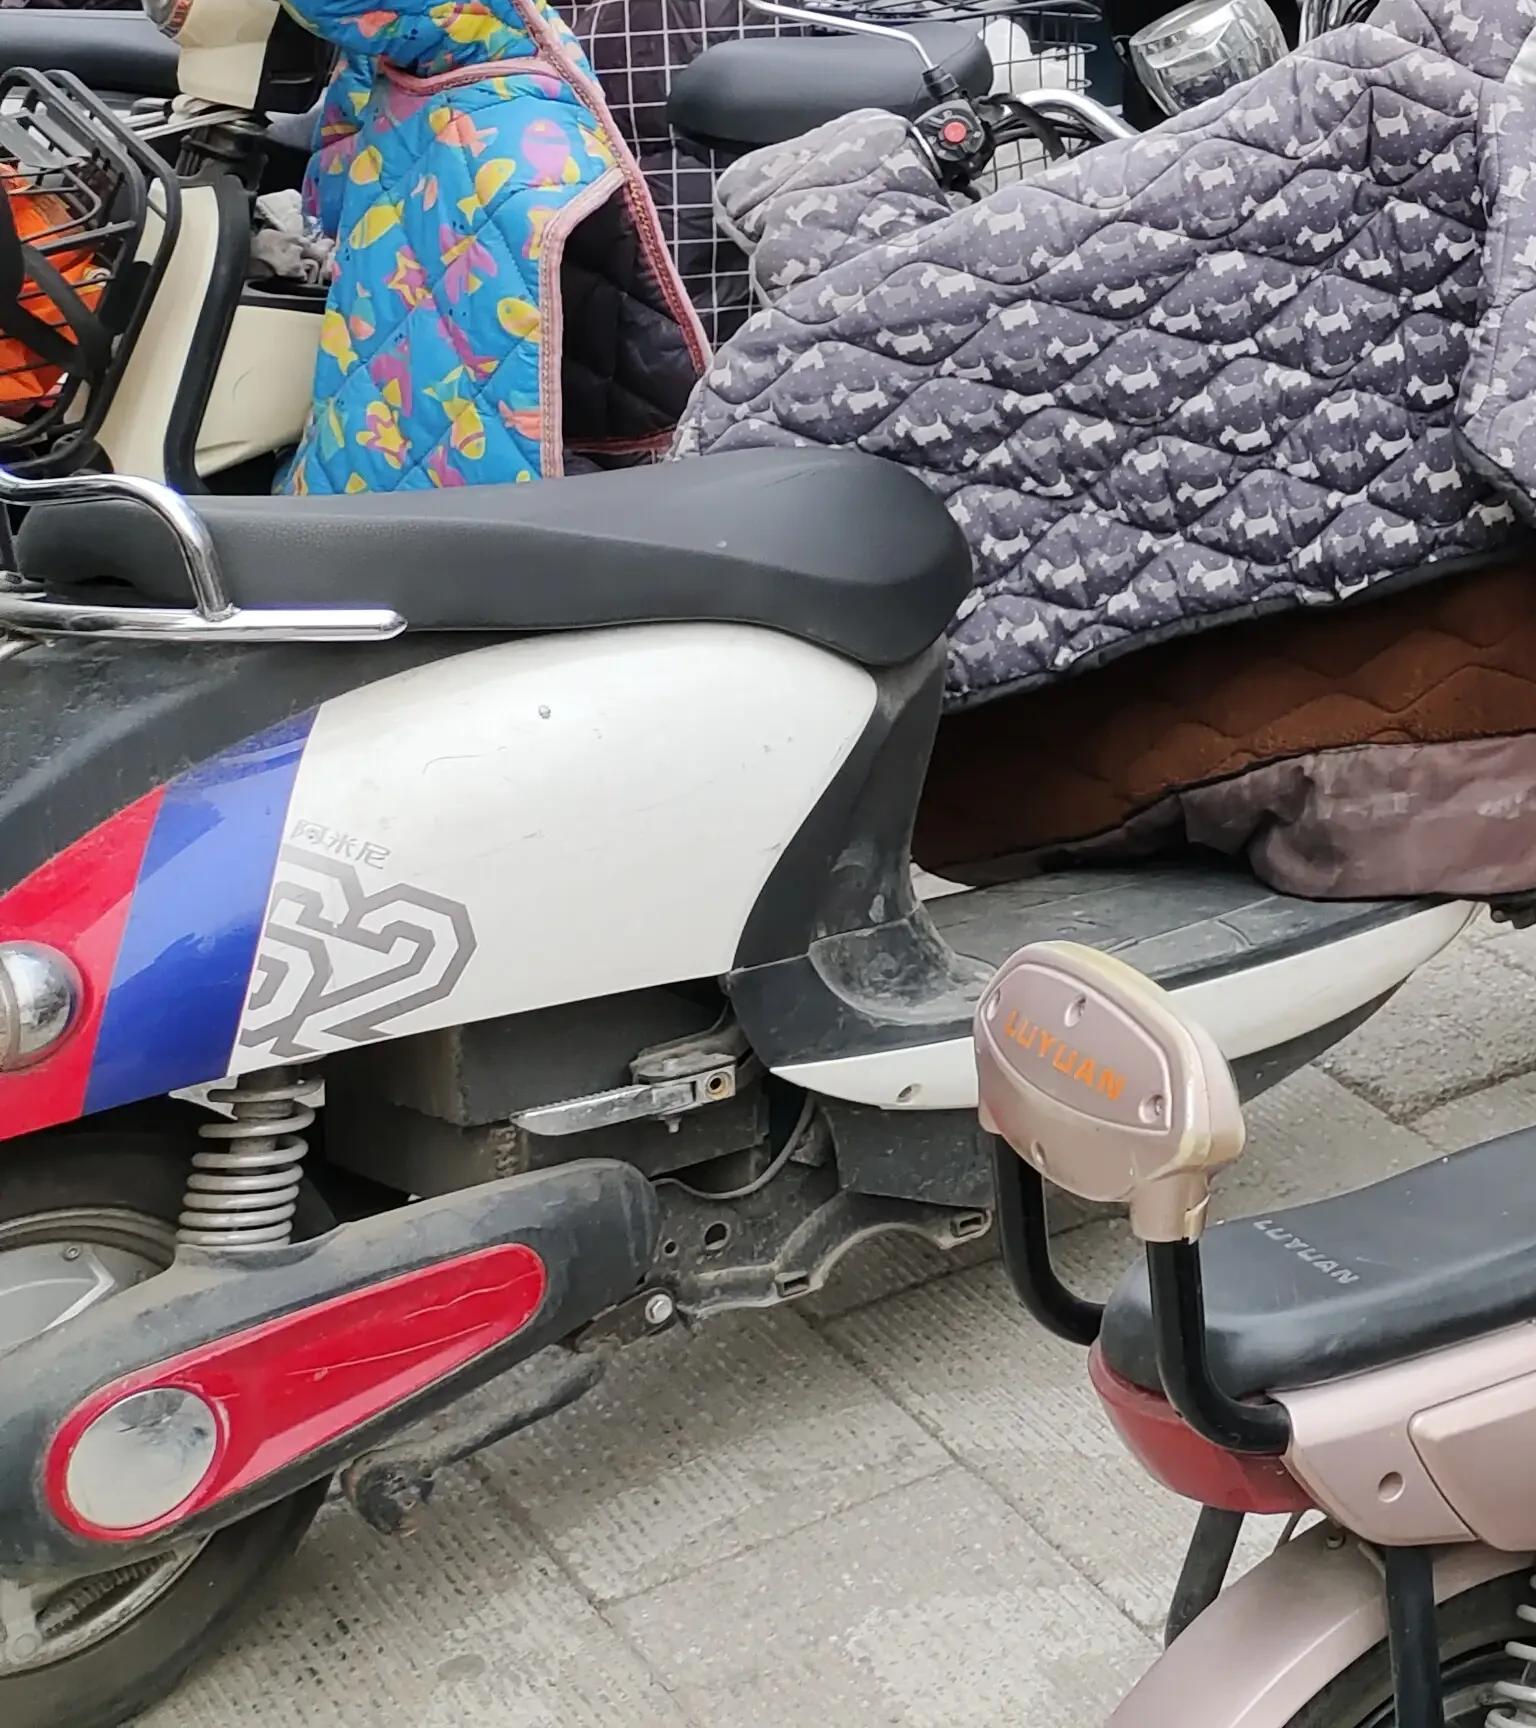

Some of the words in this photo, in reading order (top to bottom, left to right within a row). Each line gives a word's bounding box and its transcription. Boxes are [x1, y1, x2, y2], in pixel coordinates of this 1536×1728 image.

[290, 818, 392, 870] 阿米尼
[1004, 1008, 1126, 1101] LUYUAN
[1252, 1218, 1361, 1285] LUYUAN
